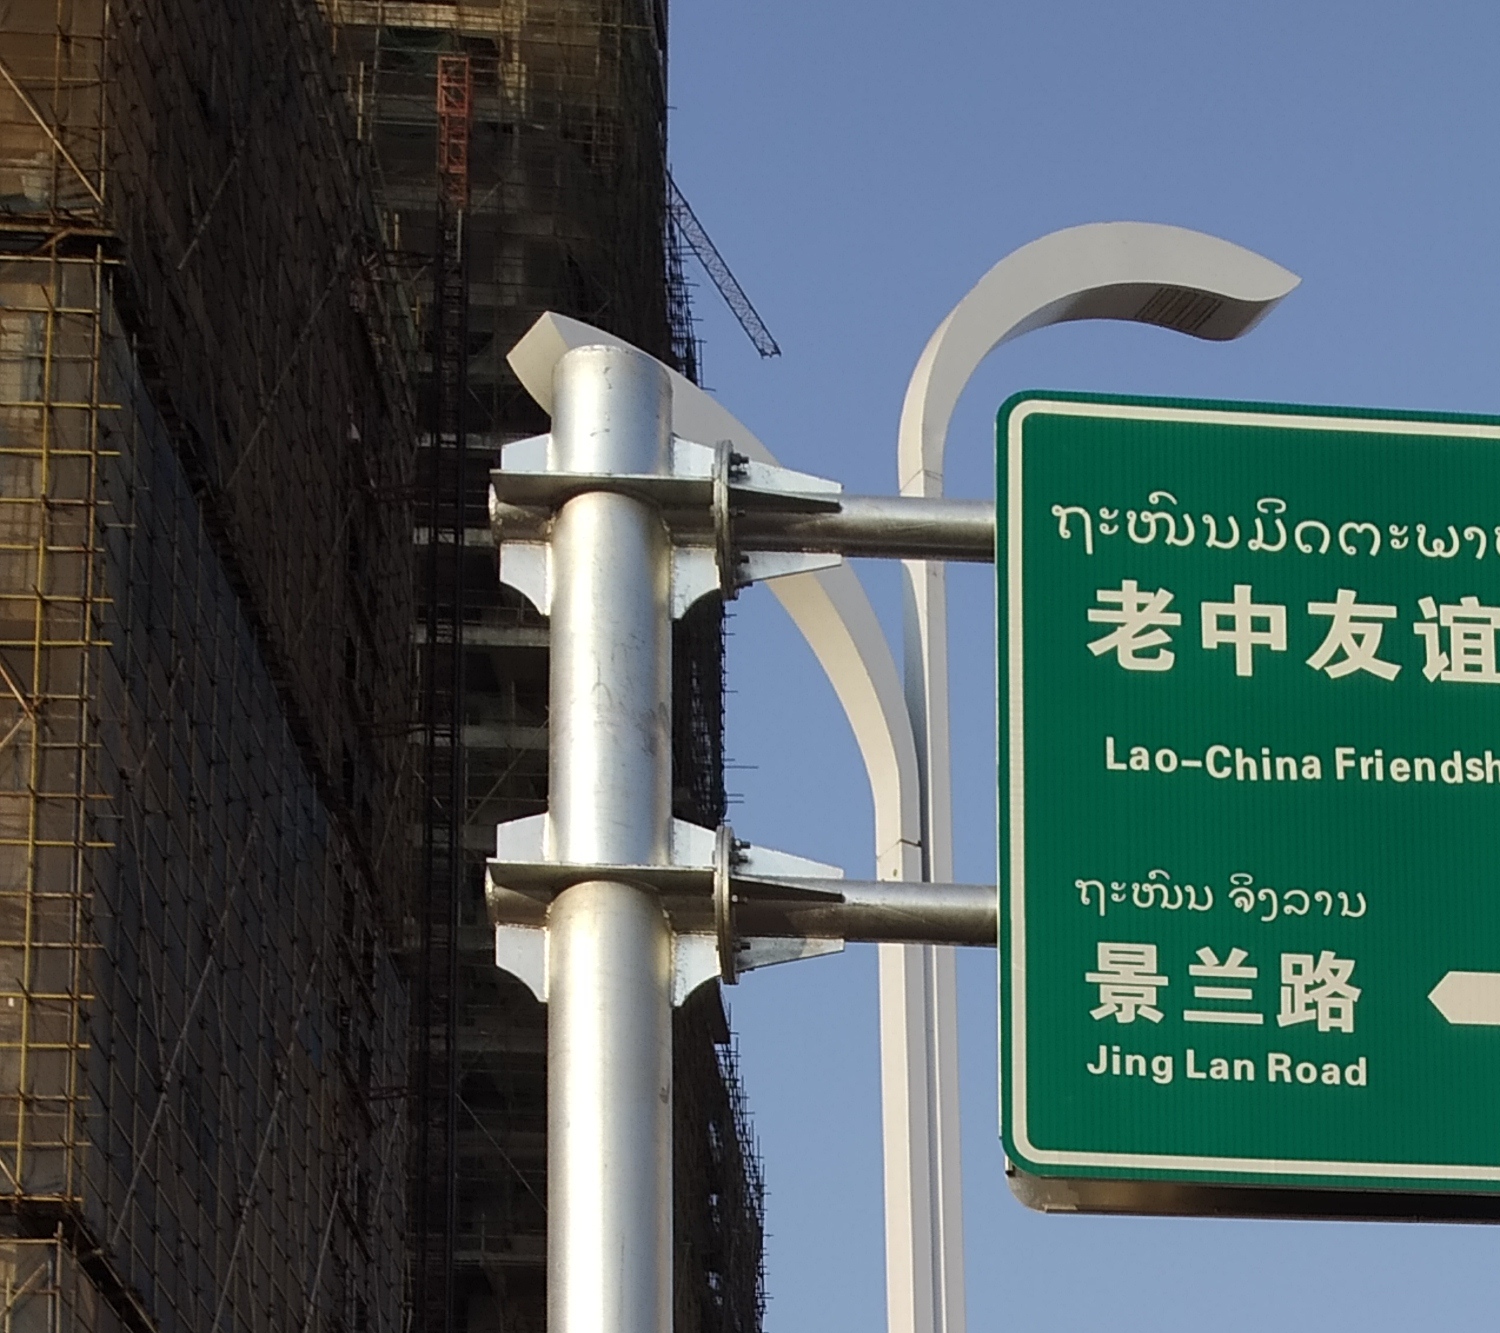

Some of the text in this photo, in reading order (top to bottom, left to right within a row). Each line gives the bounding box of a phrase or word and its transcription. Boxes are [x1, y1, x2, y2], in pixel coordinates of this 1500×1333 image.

[1105, 736, 1322, 781] Lao-China
[1085, 942, 1362, 1033] 景兰路
[1087, 1045, 1368, 1086] Jing Lan Road
